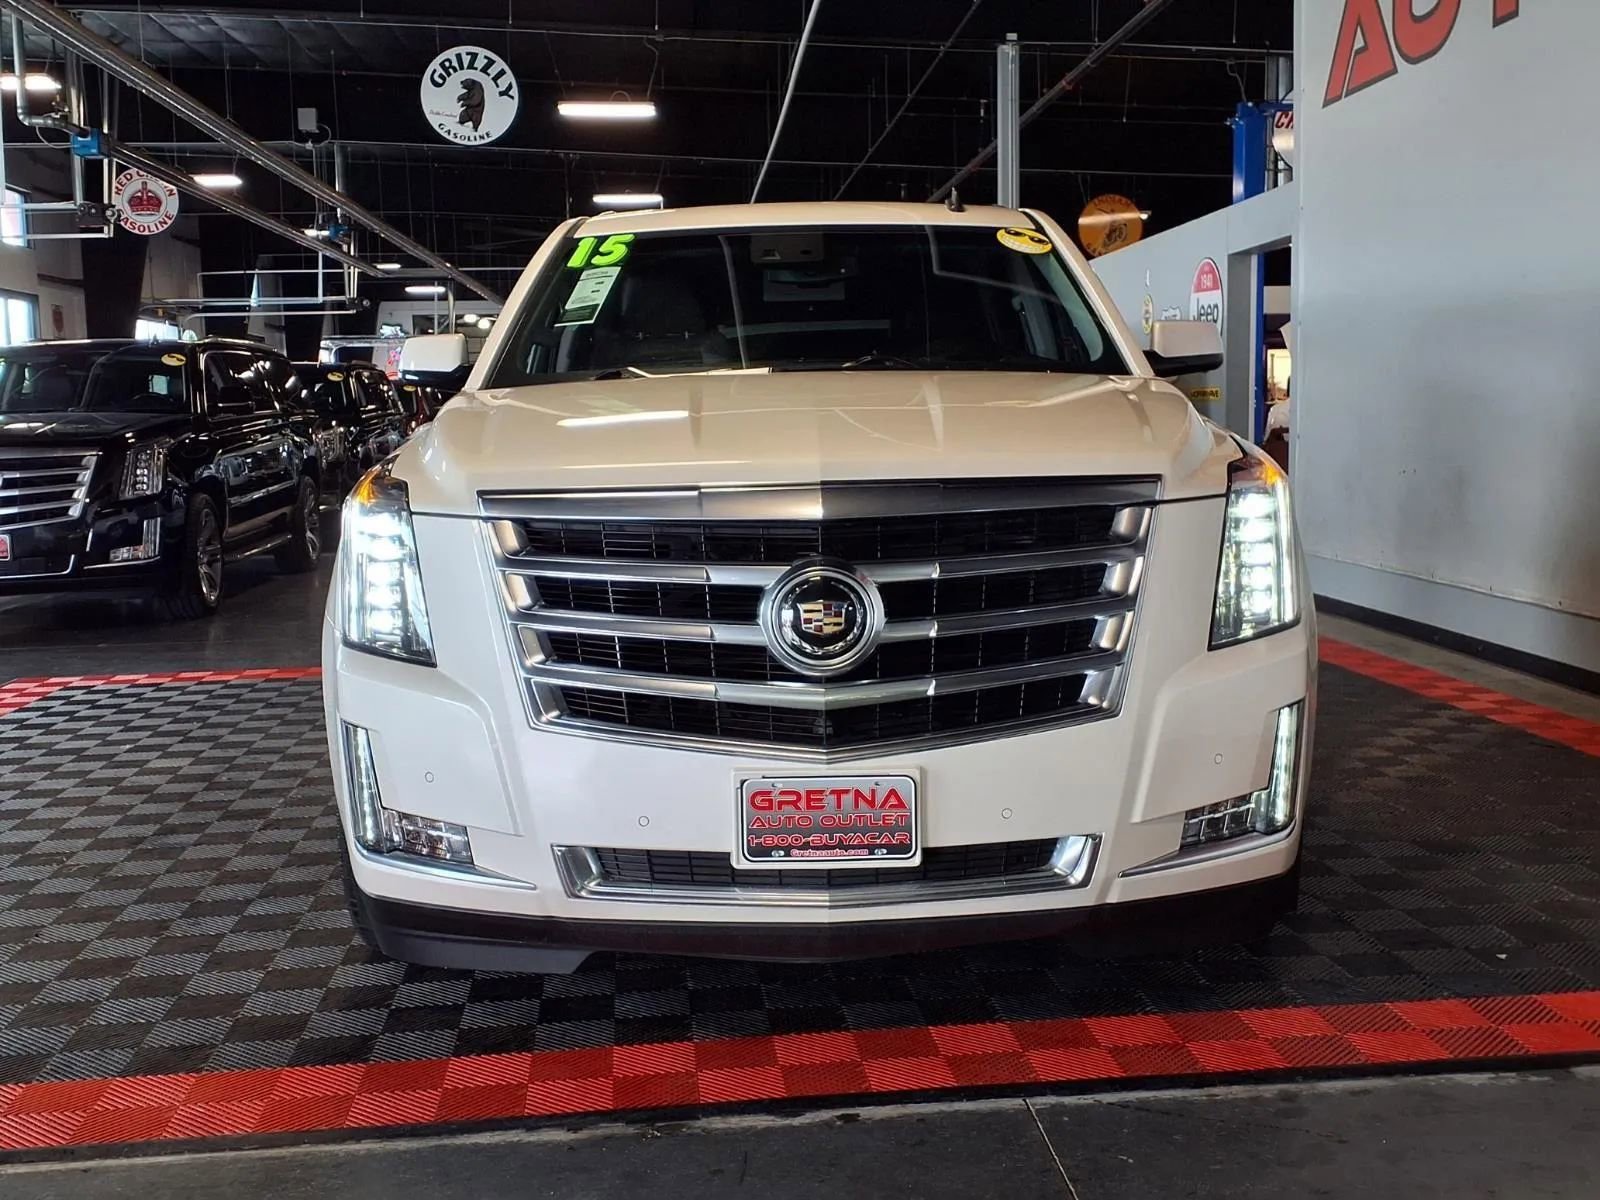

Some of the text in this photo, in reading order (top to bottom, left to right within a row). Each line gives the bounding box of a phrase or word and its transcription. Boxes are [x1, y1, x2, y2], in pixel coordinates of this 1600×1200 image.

[430, 51, 515, 101] GRIZZLY
[438, 122, 492, 141] GASOLINE
[114, 172, 133, 196] RED
[566, 233, 635, 268] 15
[748, 787, 910, 812] GRETNA
[748, 812, 910, 828] AUTO OUTLET
[748, 832, 910, 847] 1-800-BUYACAR
